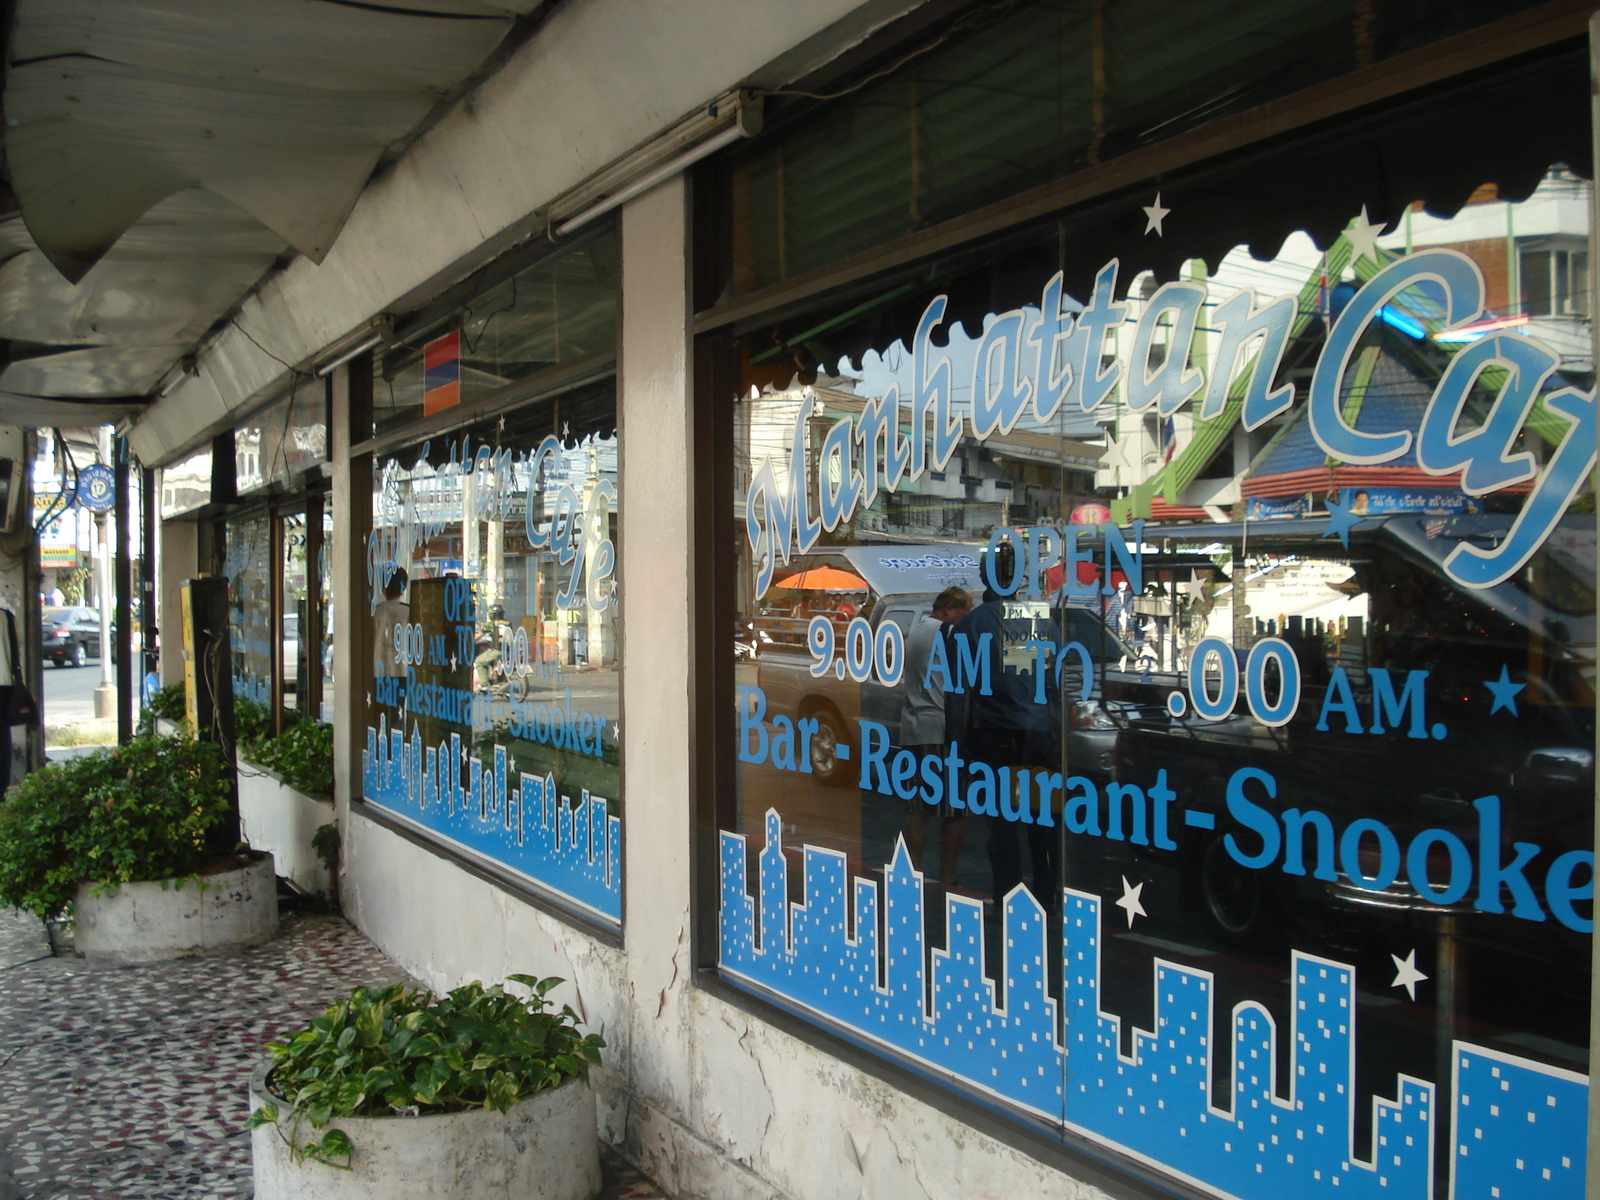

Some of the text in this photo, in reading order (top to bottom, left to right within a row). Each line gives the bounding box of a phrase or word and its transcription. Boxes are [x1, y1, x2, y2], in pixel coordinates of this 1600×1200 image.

[747, 257, 1295, 600] Manhattan
[526, 434, 615, 613] Cafe
[986, 519, 1146, 597] OPEN
[455, 625, 476, 667] TO
[808, 615, 905, 687] 9.00
[923, 630, 993, 696] AM
[1025, 640, 1094, 706] TO
[1315, 667, 1448, 741] AM.
